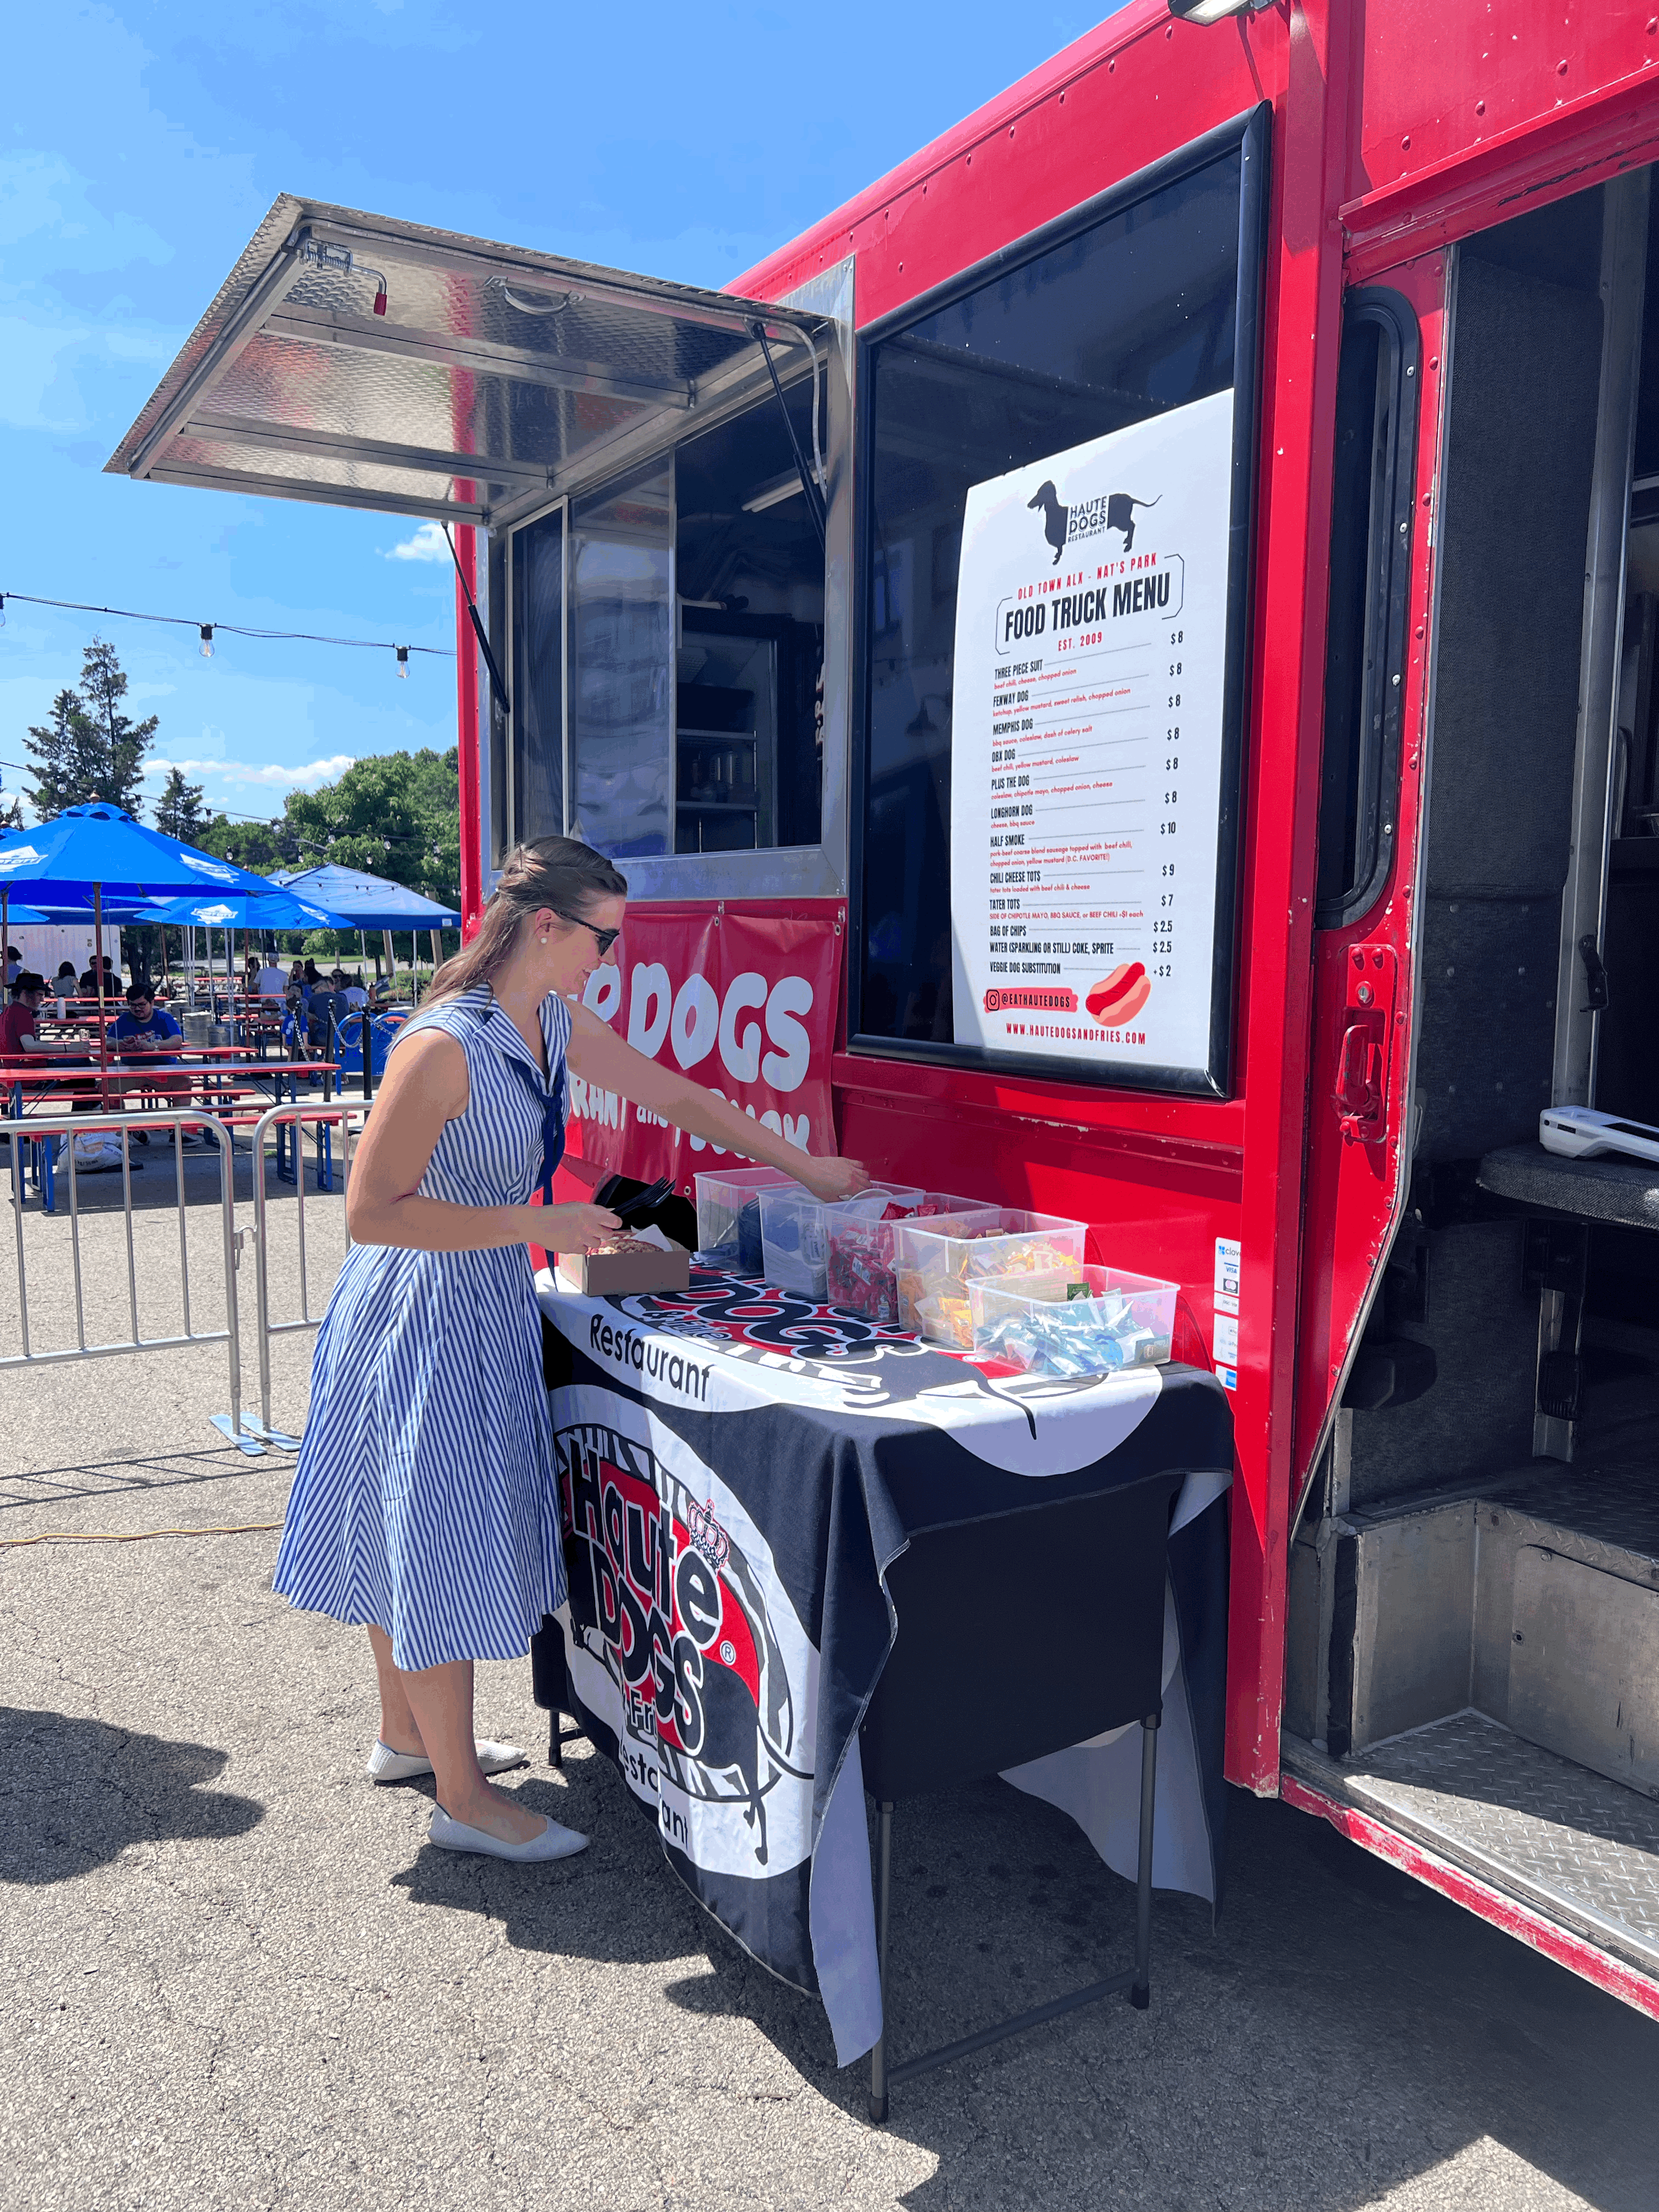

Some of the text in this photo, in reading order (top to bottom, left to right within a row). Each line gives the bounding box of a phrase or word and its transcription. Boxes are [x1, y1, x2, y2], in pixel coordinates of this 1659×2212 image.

[1070, 496, 1107, 518] HAUTE
[1068, 510, 1107, 535] DOGS
[1068, 527, 1105, 543] RESTAURANT
[1018, 585, 1033, 600] OLD
[1039, 578, 1062, 595] TOWN
[1066, 572, 1083, 587] ALX
[1097, 561, 1125, 580] NAT'S
[1131, 552, 1156, 573] PARK
[1005, 572, 1170, 642] FOOD TRUCK MENU
[1058, 631, 1102, 651] EST. 2009
[995, 659, 1043, 680] THREE PIECE SUIT
[993, 690, 1029, 707] FENWAY DOG
[993, 718, 1033, 735] MEMPHIS DOG
[992, 748, 1015, 762] OBX DOG
[991, 775, 1030, 790] PLUS THE DOG
[991, 804, 1032, 819] LONGHORN DOG
[990, 834, 1025, 847] HALF SMOKE
[990, 871, 1041, 884] CHILI CHEESE TOTS
[989, 899, 1020, 910] TATER TOTS
[990, 925, 1026, 936] BAG OF CHIPS
[990, 942, 1114, 955] WATER (SPARKLING OR STILL) COKE, SPRITE
[990, 961, 1061, 974] VEGGIE DOG SUBSTITUTION
[1002, 992, 1070, 1008] @EATHAUTEDOGS
[627, 962, 814, 1092] DOGS
[1006, 1023, 1146, 1045] WWW.HAUTEDOGSANDFRIES.COM
[1226, 1266, 1237, 1274] VISA
[589, 1313, 710, 1402] Restaurant
